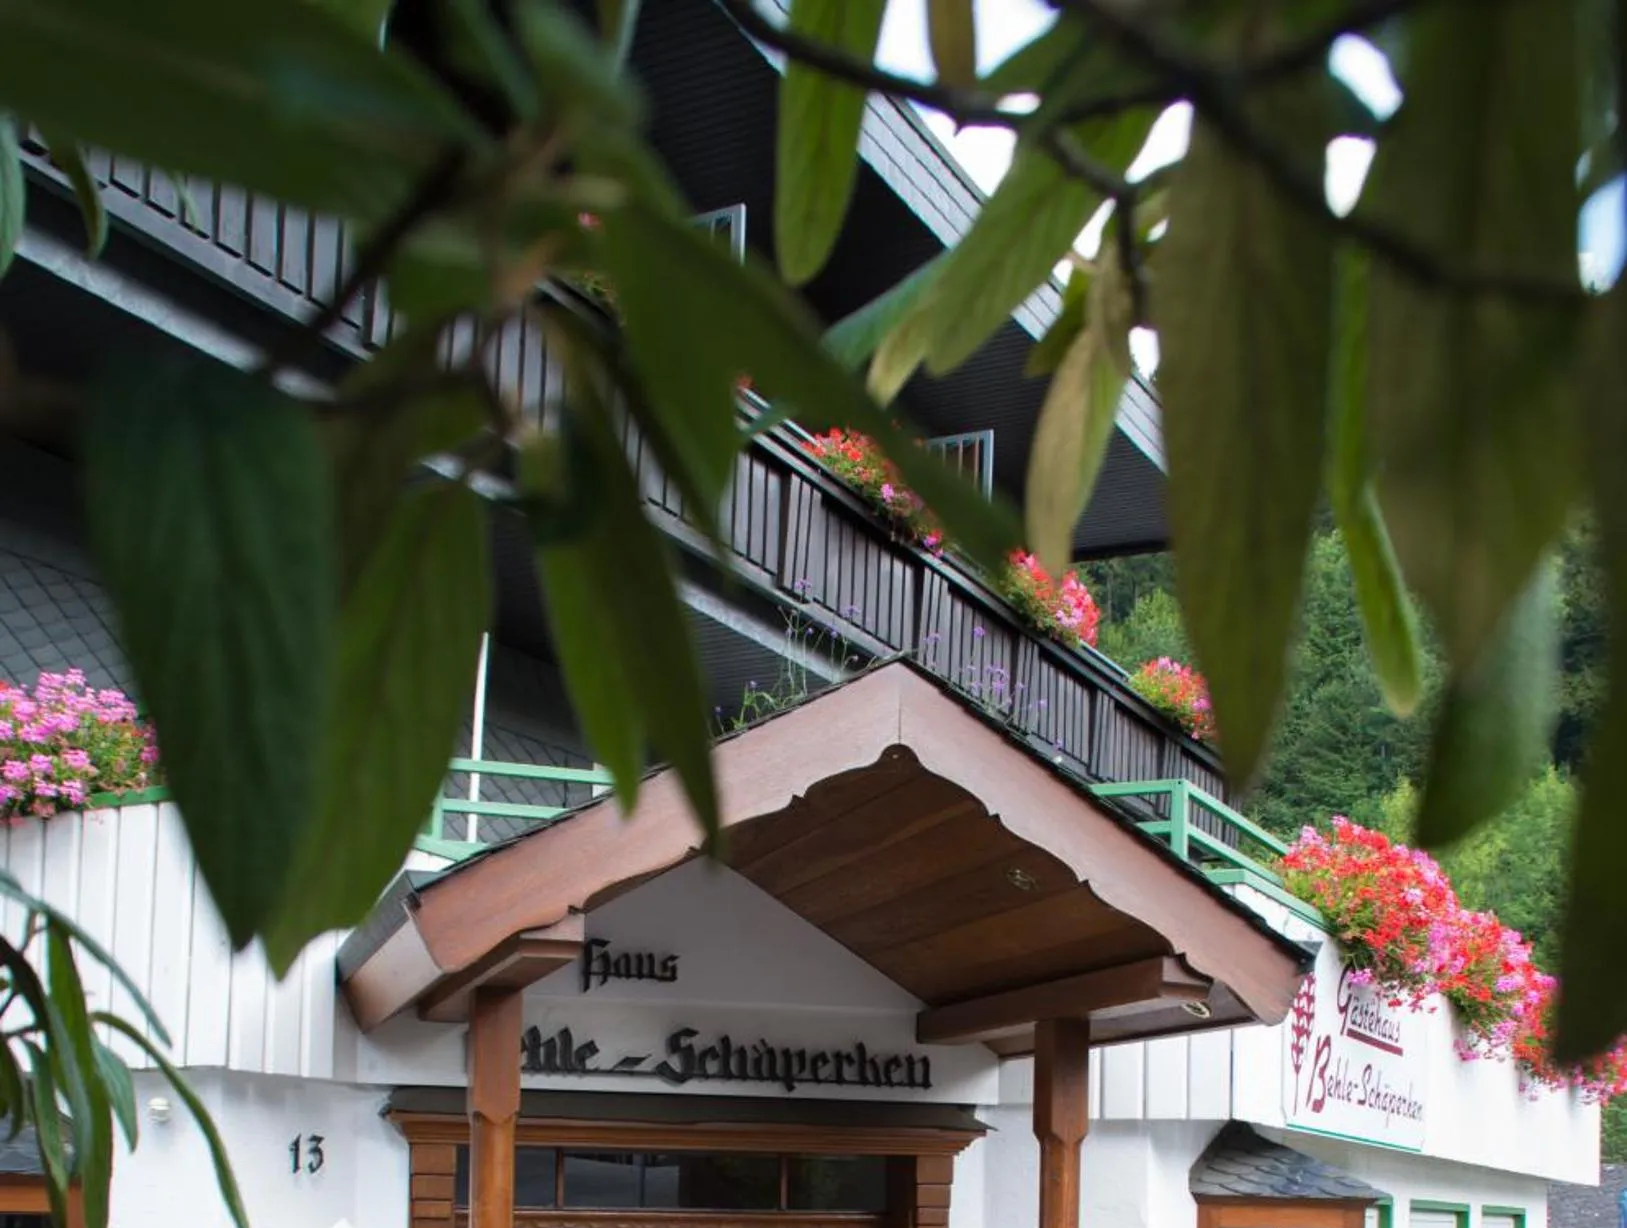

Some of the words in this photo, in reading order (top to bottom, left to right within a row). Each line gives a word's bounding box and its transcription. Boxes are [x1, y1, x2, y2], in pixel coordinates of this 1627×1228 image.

[583, 938, 680, 993] Haus
[1336, 963, 1401, 1044] Gästehaus
[288, 1132, 325, 1174] 13
